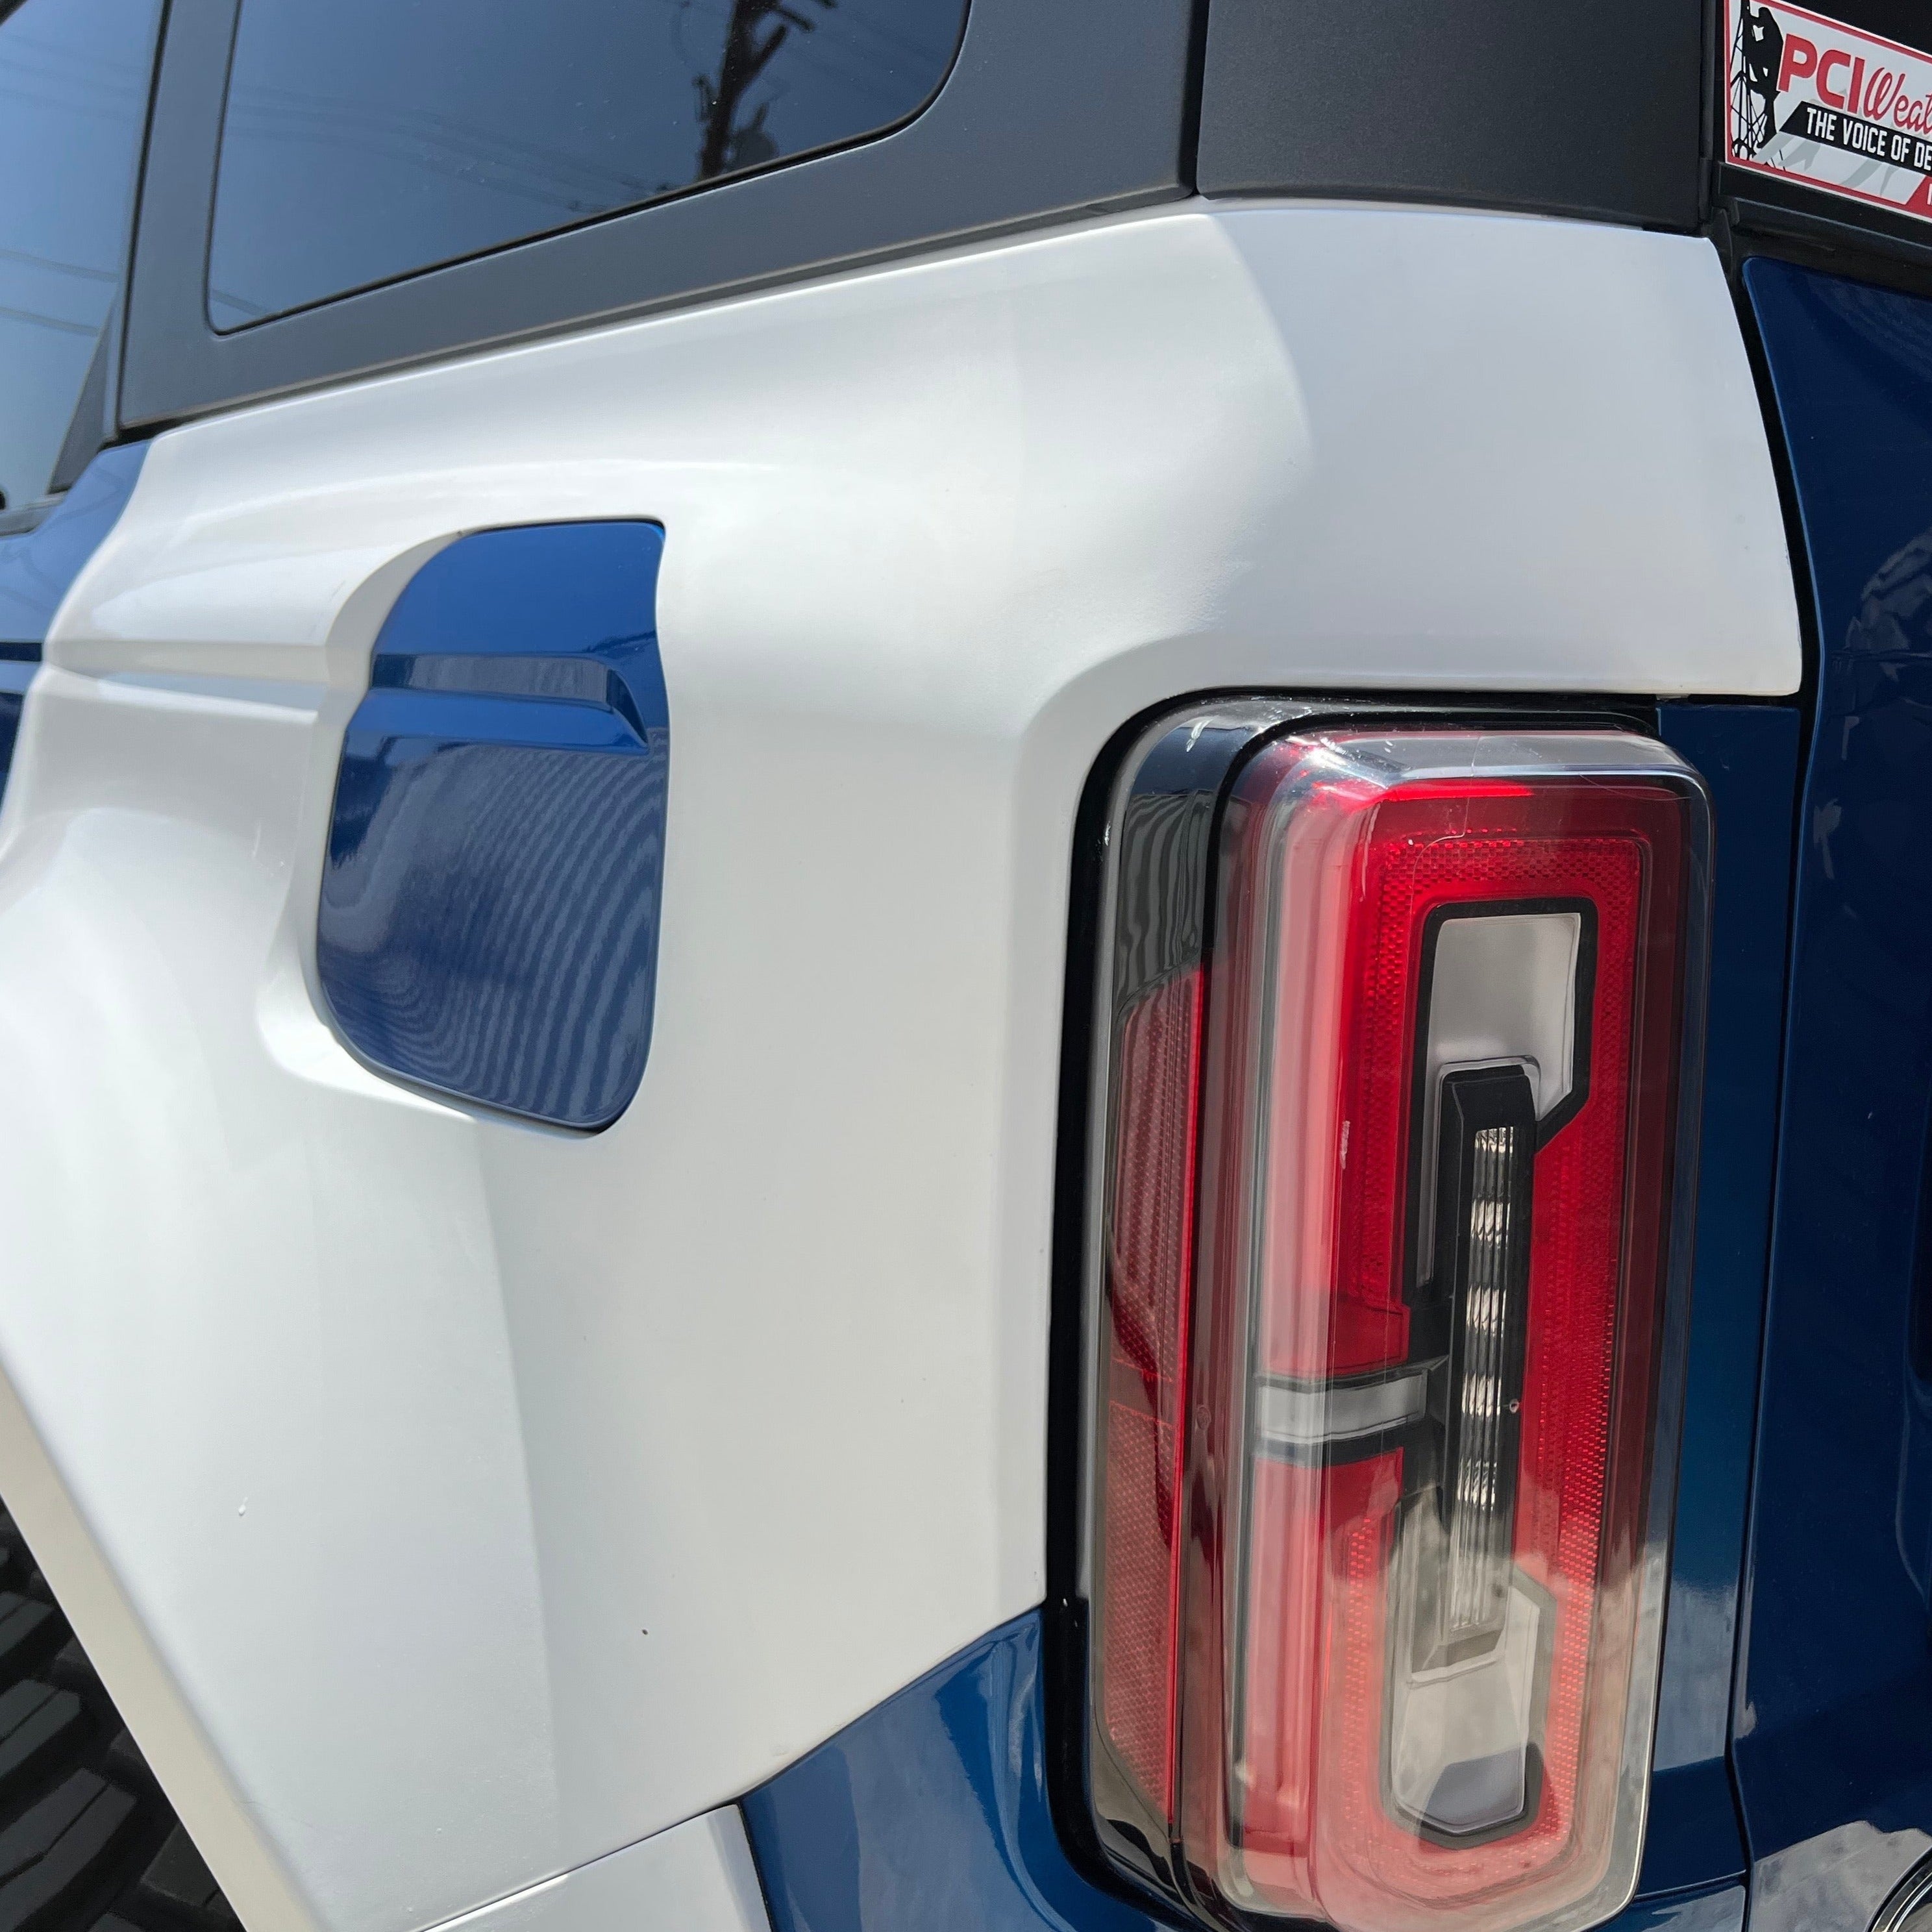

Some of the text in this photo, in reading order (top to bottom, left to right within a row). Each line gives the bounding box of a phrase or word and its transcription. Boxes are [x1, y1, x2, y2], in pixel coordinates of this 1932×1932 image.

[1807, 106, 1932, 171] THE VOICE OF DE
